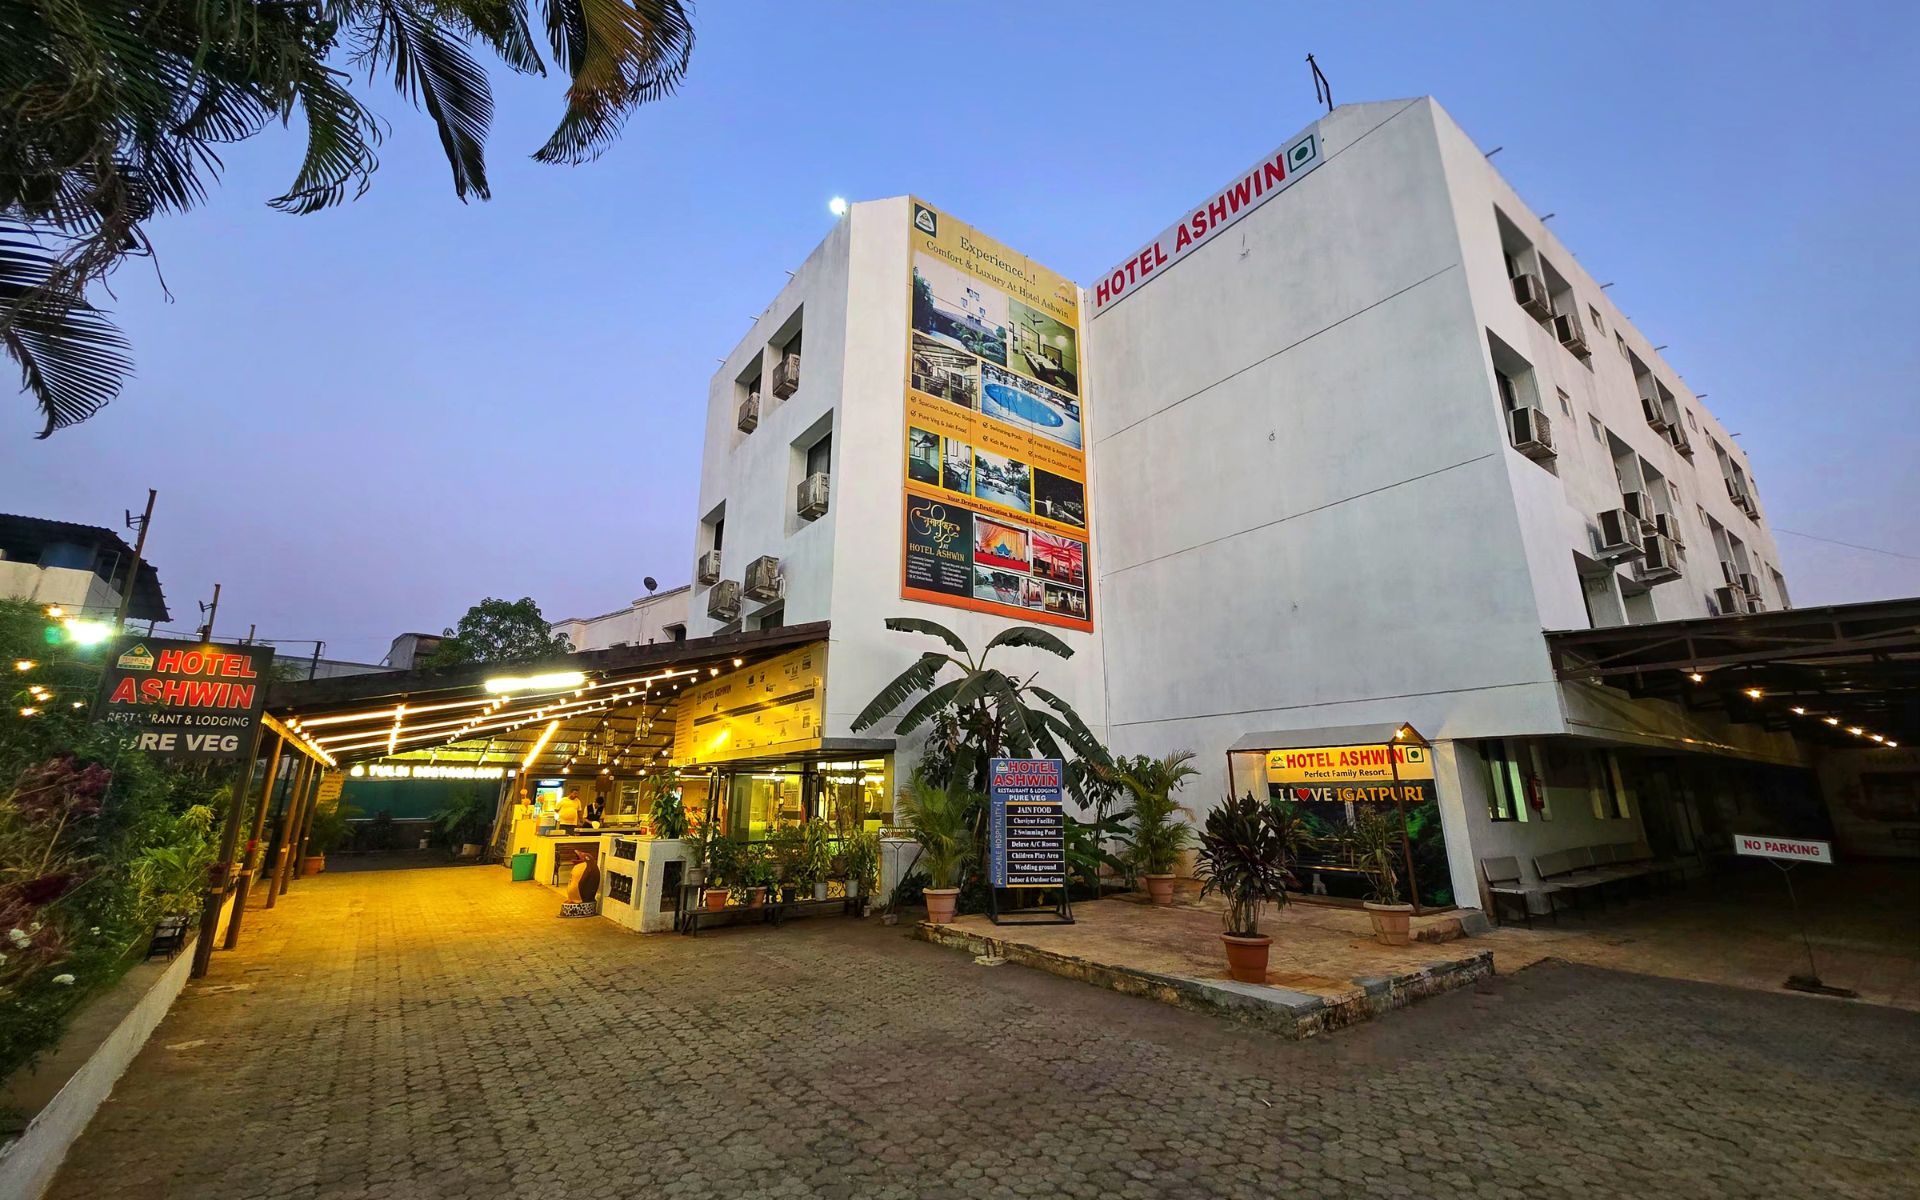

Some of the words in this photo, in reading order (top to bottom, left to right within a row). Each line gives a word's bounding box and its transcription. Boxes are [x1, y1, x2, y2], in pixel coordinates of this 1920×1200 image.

[1096, 242, 1168, 308] HOTEL
[1175, 153, 1286, 253] ASHWIN
[926, 240, 963, 266] Comfort
[966, 260, 973, 270] &
[976, 264, 1005, 288] Luxury
[1007, 282, 1018, 293] At
[1020, 286, 1040, 303] Hotel
[1041, 298, 1069, 319] Ashwin
[930, 417, 939, 426] Veg
[1000, 441, 1008, 449] Play
[961, 498, 979, 509] Dream
[979, 504, 1008, 516] Destination
[1008, 512, 1029, 523] Wedding
[909, 542, 934, 555] HOTEL
[936, 550, 965, 562] ASHWIN
[157, 649, 258, 678] HOTEL
[109, 677, 256, 709] ASHWIN
[184, 715, 192, 725] &
[195, 716, 249, 727] LODGING
[186, 734, 239, 752] VEG
[1286, 752, 1335, 769] HOTEL
[1340, 748, 1405, 766] ASHWIN
[1008, 761, 1058, 774] HOTEL
[1332, 770, 1356, 779] Family
[993, 774, 1058, 787] ASHWIN
[1278, 788, 1286, 801] I
[1336, 786, 1424, 802] IGATPURI
[1744, 840, 1761, 850] NO
[1764, 841, 1820, 856] PARKING
